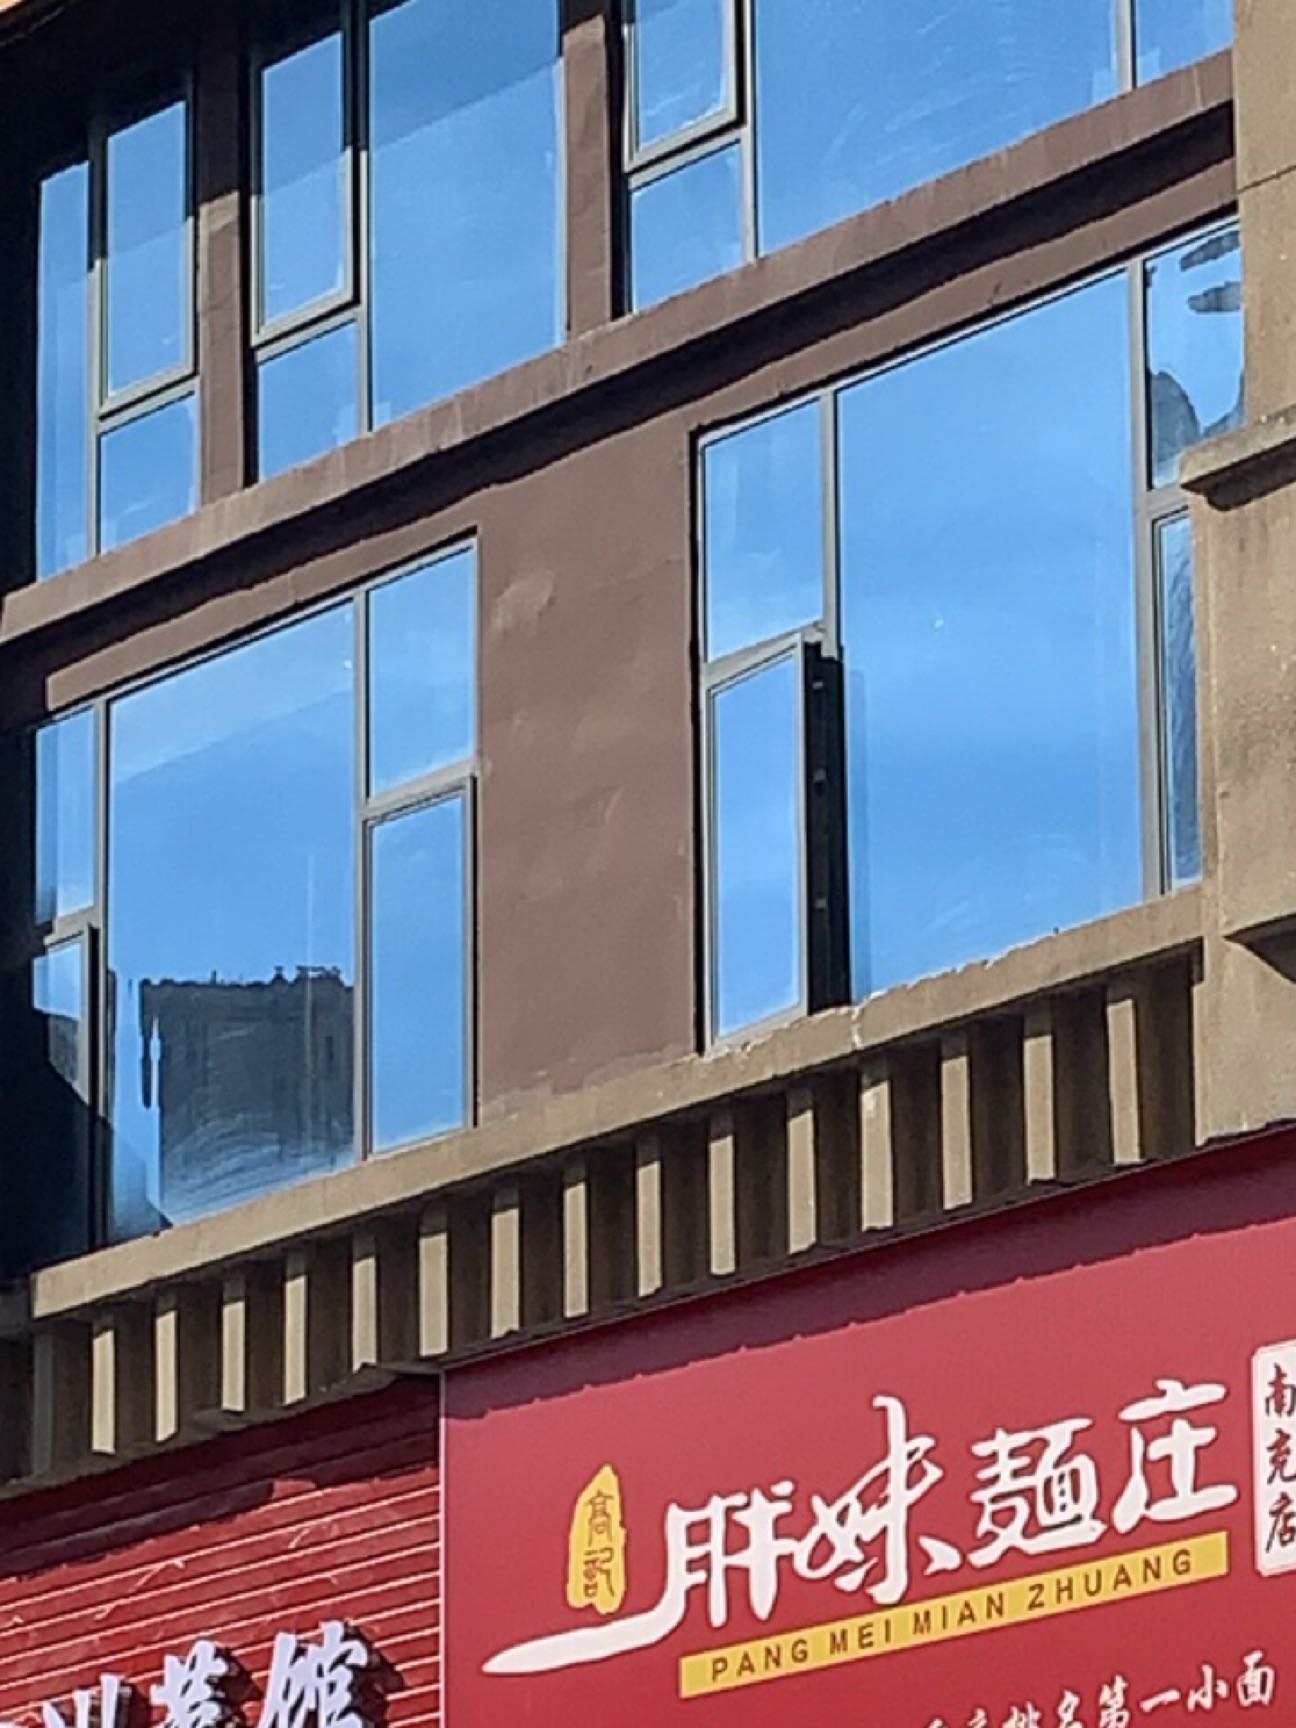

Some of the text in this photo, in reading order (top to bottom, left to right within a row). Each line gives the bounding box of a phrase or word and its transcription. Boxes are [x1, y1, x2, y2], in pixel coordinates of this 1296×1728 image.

[711, 1546, 1195, 1683] PANG MEI MIAN ZHUANG
